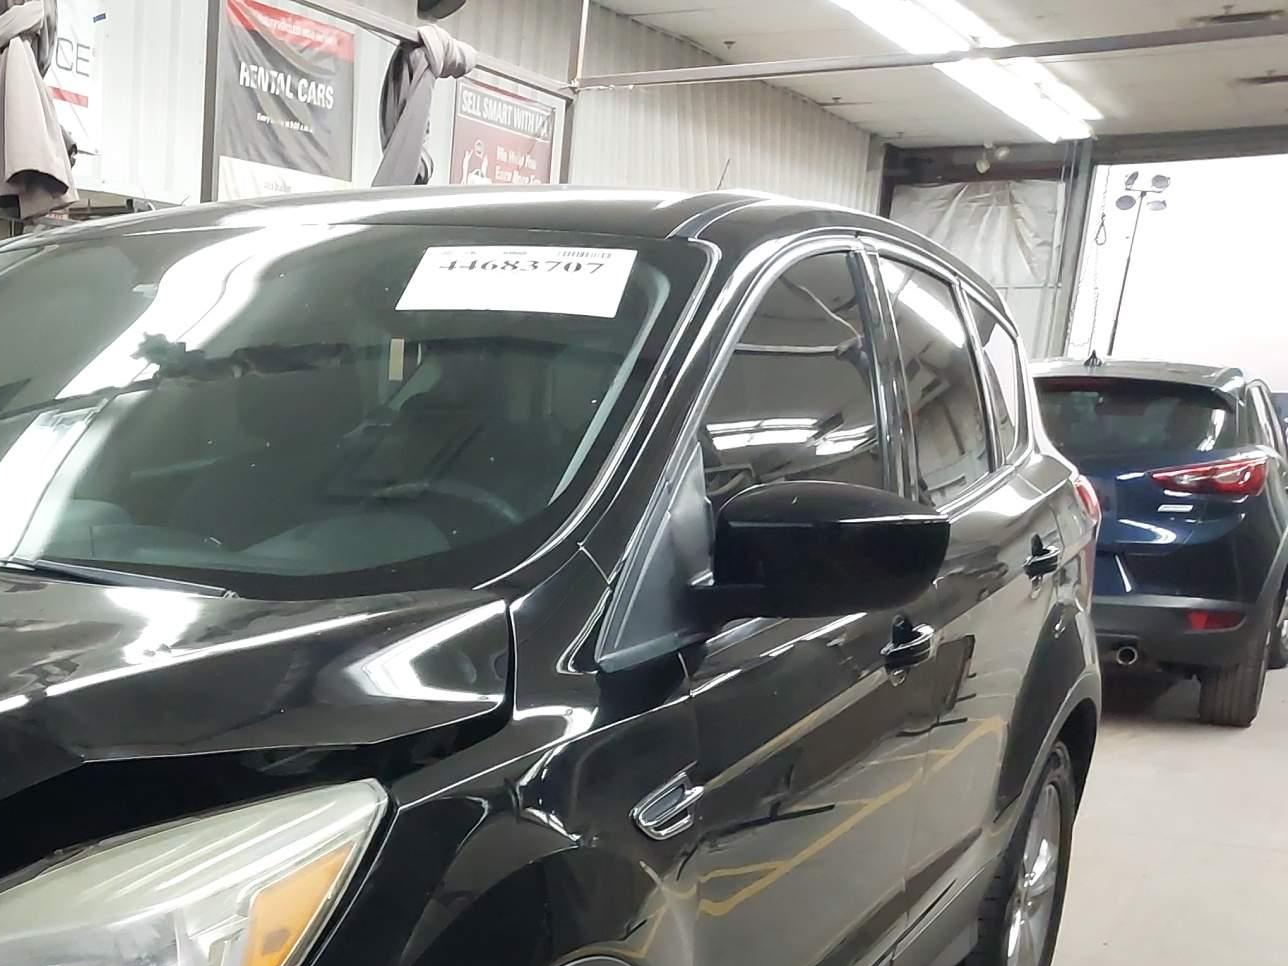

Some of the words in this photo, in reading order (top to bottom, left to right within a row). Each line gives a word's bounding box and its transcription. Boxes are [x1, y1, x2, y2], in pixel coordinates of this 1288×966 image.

[239, 61, 294, 99] RENTAL
[297, 78, 334, 110] CARS
[461, 90, 481, 117] SELL
[482, 97, 512, 126] SMART
[513, 107, 534, 133] WITH
[439, 259, 605, 274] 44683707
